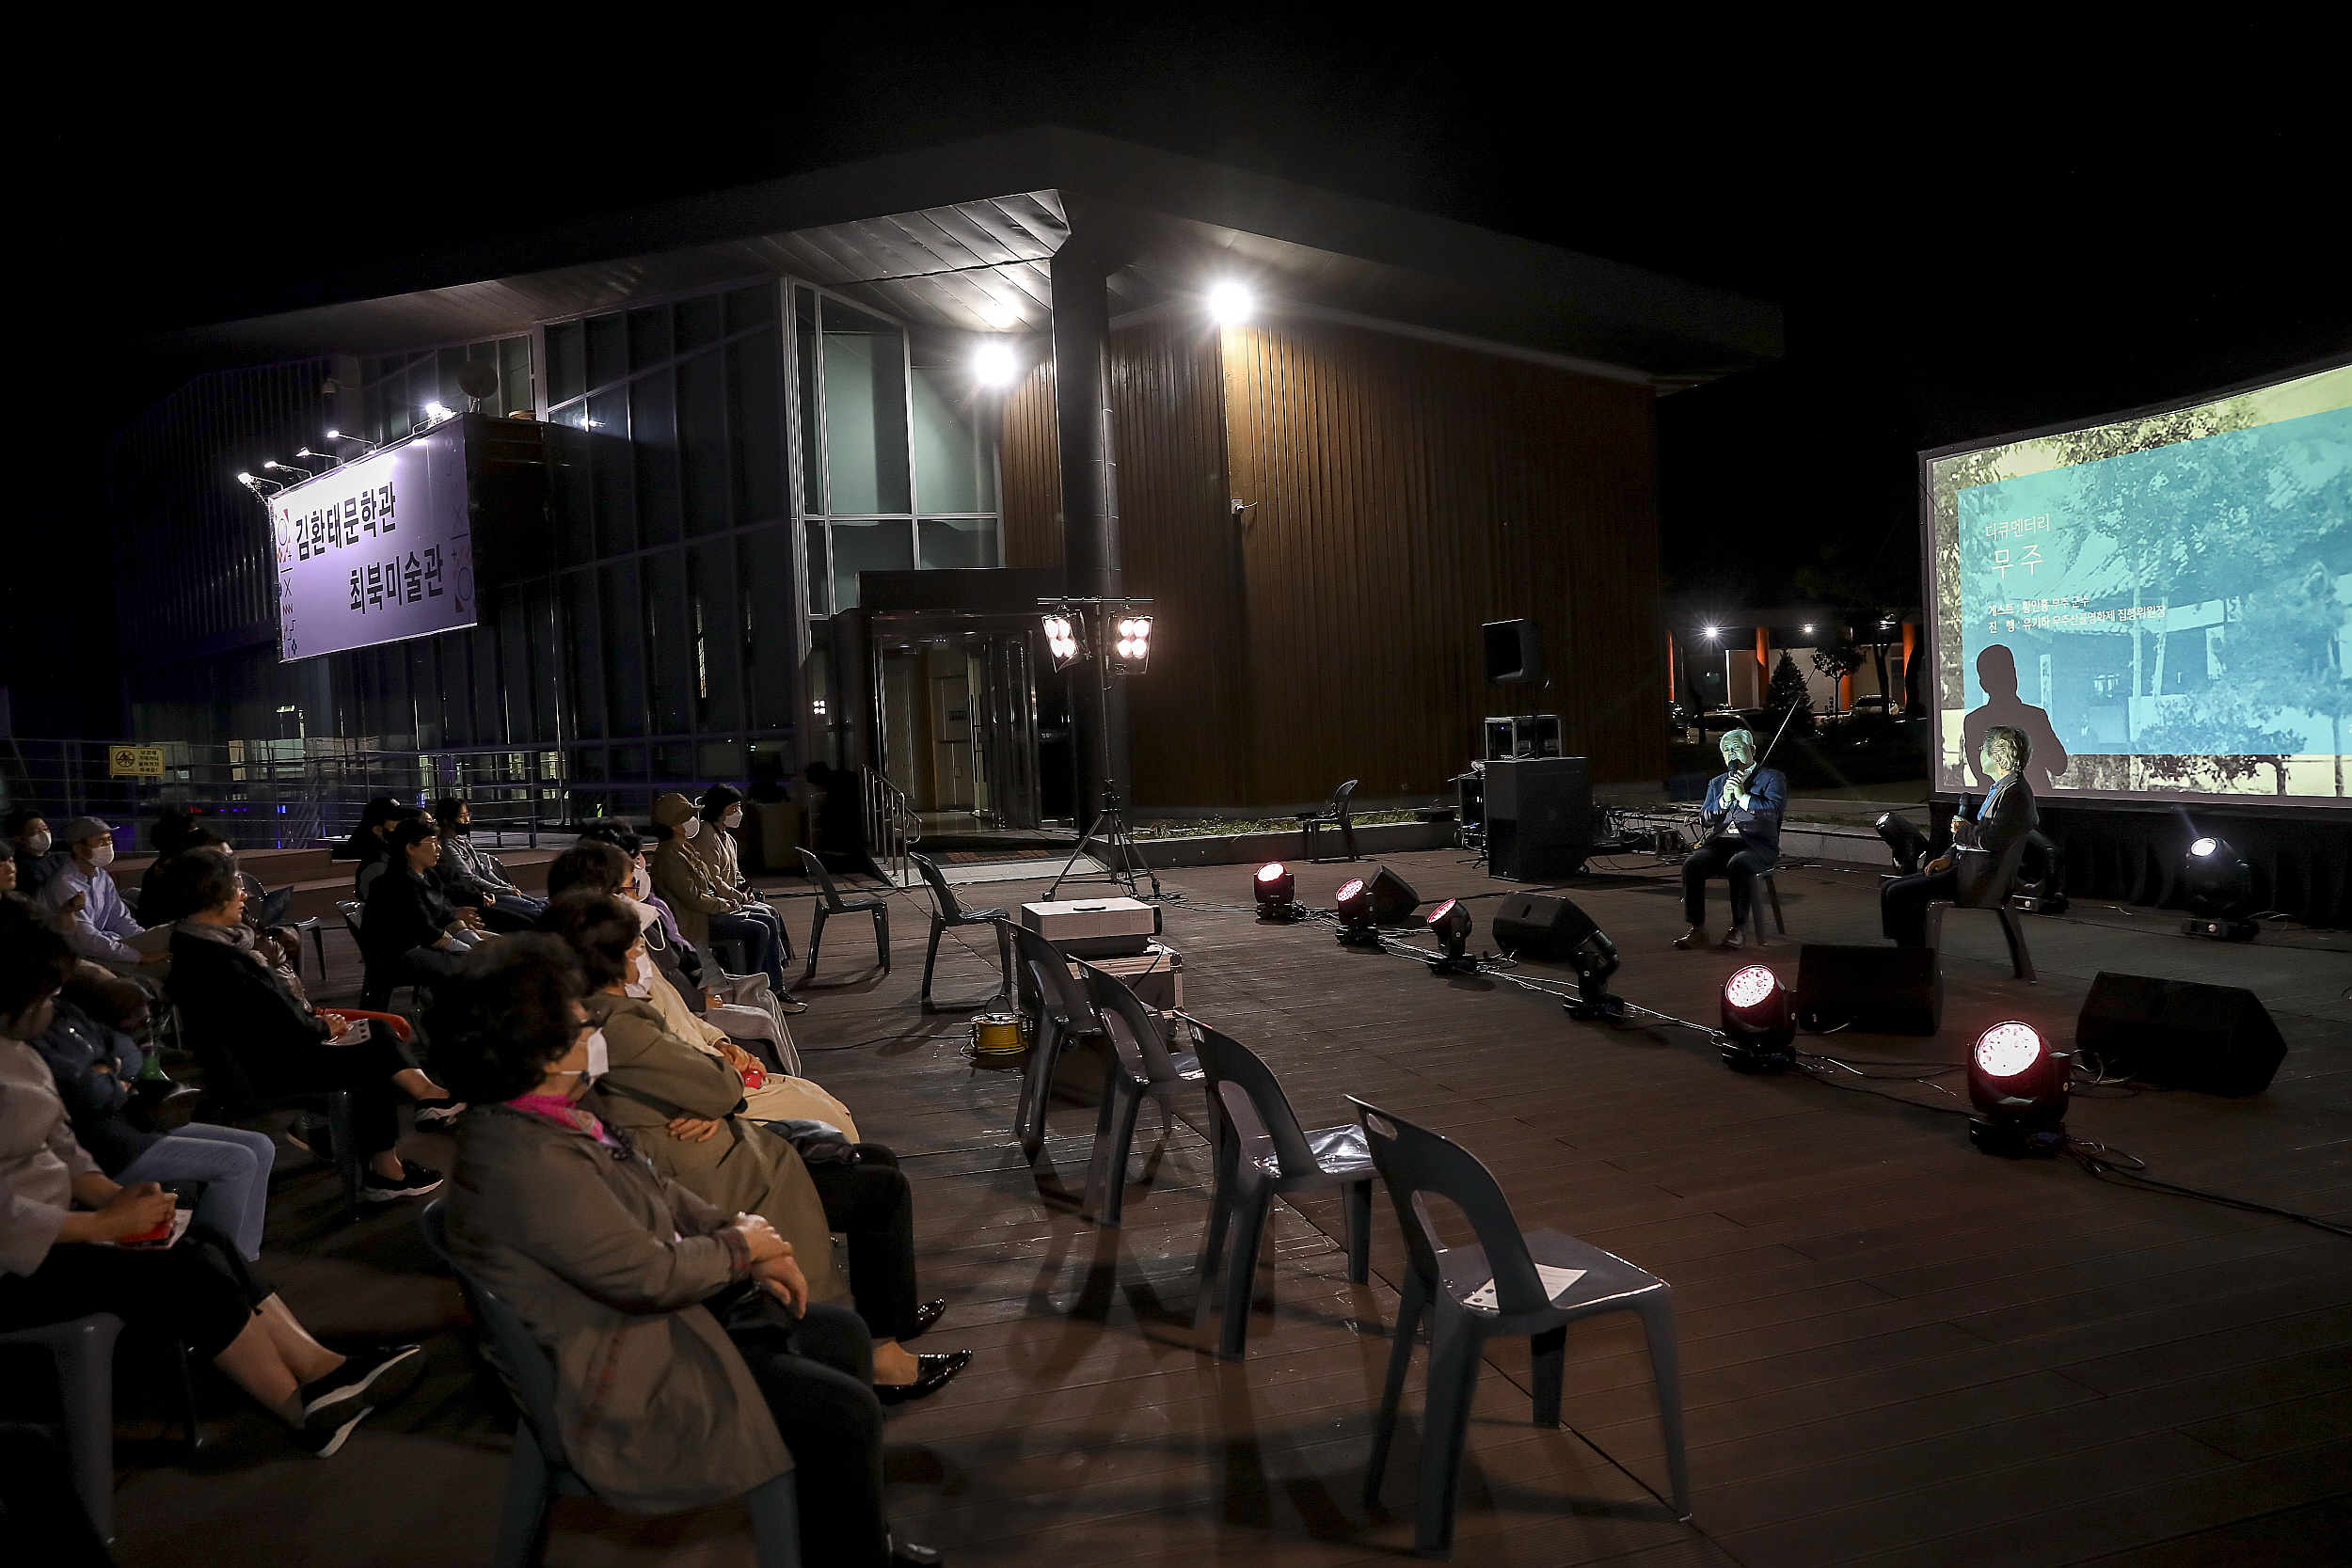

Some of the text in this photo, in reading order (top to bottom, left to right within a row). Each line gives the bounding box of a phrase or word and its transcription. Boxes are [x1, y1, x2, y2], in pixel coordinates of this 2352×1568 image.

[295, 482, 396, 562] 김환태문학관
[1985, 514, 2050, 541] 다큐멘터리
[349, 544, 444, 614] 최북미술관
[2052, 596, 2070, 610] 무주
[2071, 595, 2090, 609] 군수
[2023, 615, 2050, 630] 유기하
[2052, 610, 2116, 627] 무주산골영화제
[2117, 604, 2167, 622] 집행위원장
